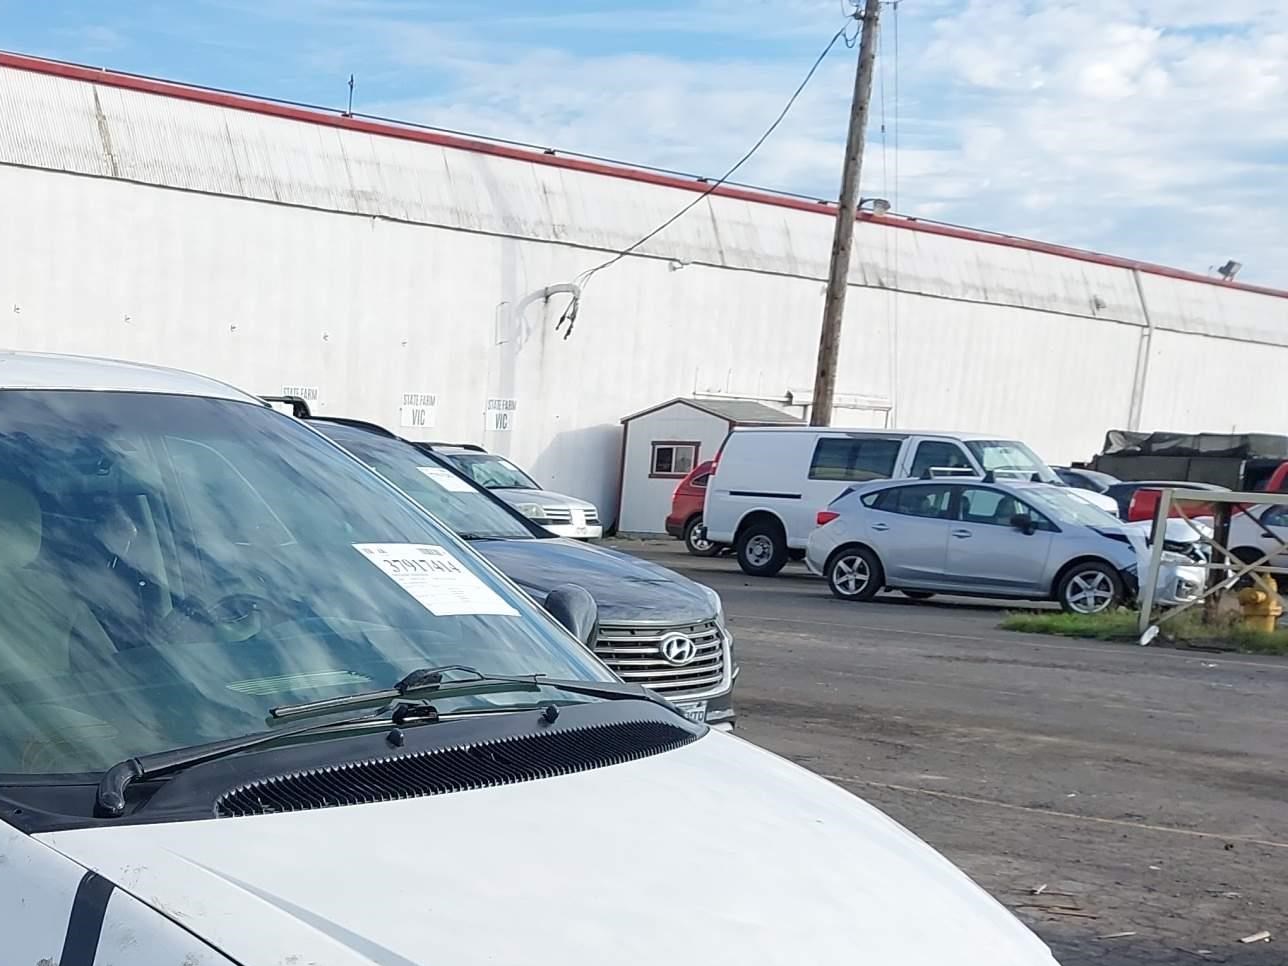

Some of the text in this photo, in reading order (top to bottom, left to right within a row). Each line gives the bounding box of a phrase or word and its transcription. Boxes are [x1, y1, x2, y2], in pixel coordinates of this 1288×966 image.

[403, 394, 436, 407] STATE FARM
[487, 399, 517, 411] STATE FARM
[412, 409, 426, 426] VIC
[495, 413, 508, 430] VIC
[384, 559, 462, 574] 37917414
